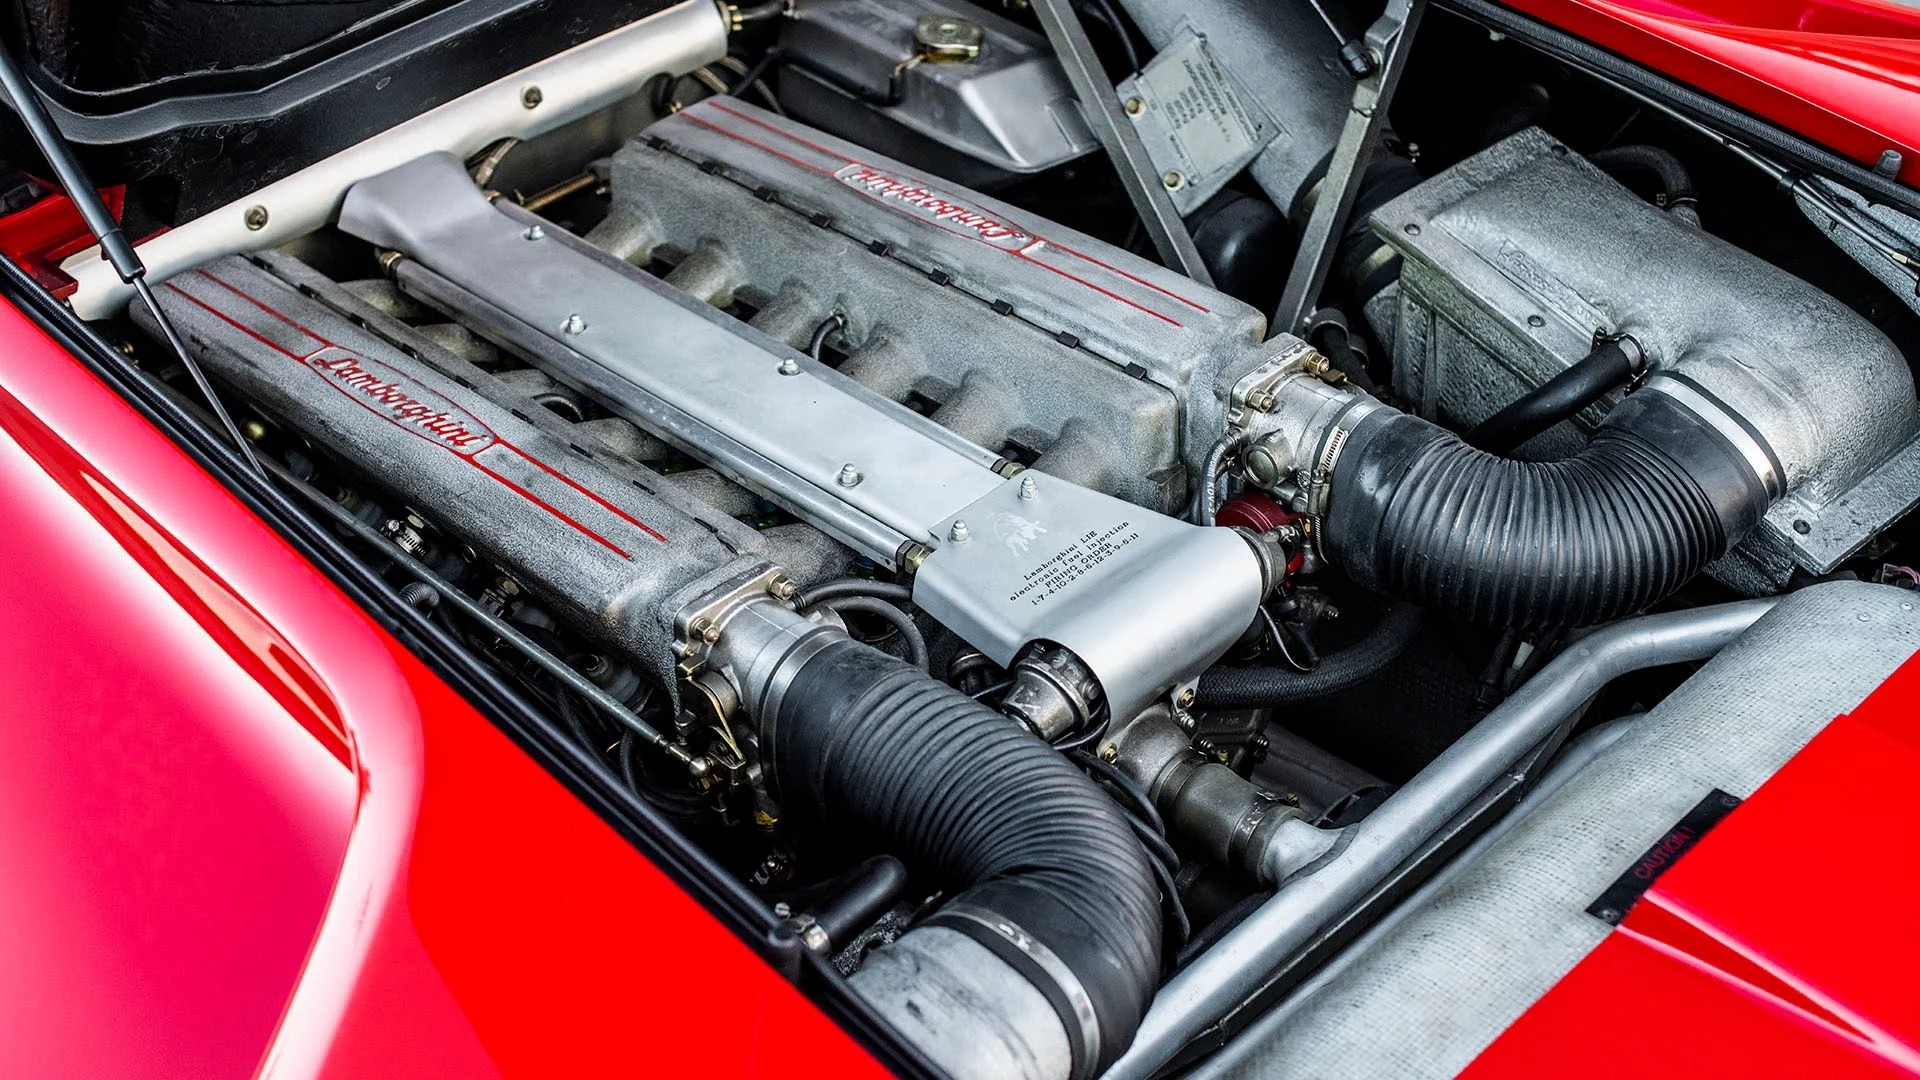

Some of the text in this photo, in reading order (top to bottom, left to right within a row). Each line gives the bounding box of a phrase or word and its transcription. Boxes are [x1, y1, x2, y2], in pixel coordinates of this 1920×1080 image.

[844, 168, 1027, 241] Lamborghini
[313, 358, 490, 446] Lamborghini
[1010, 521, 1129, 601] electronic fuel injection
[1024, 544, 1078, 581] Lamborghini
[1045, 542, 1112, 588] FIRING ORDER
